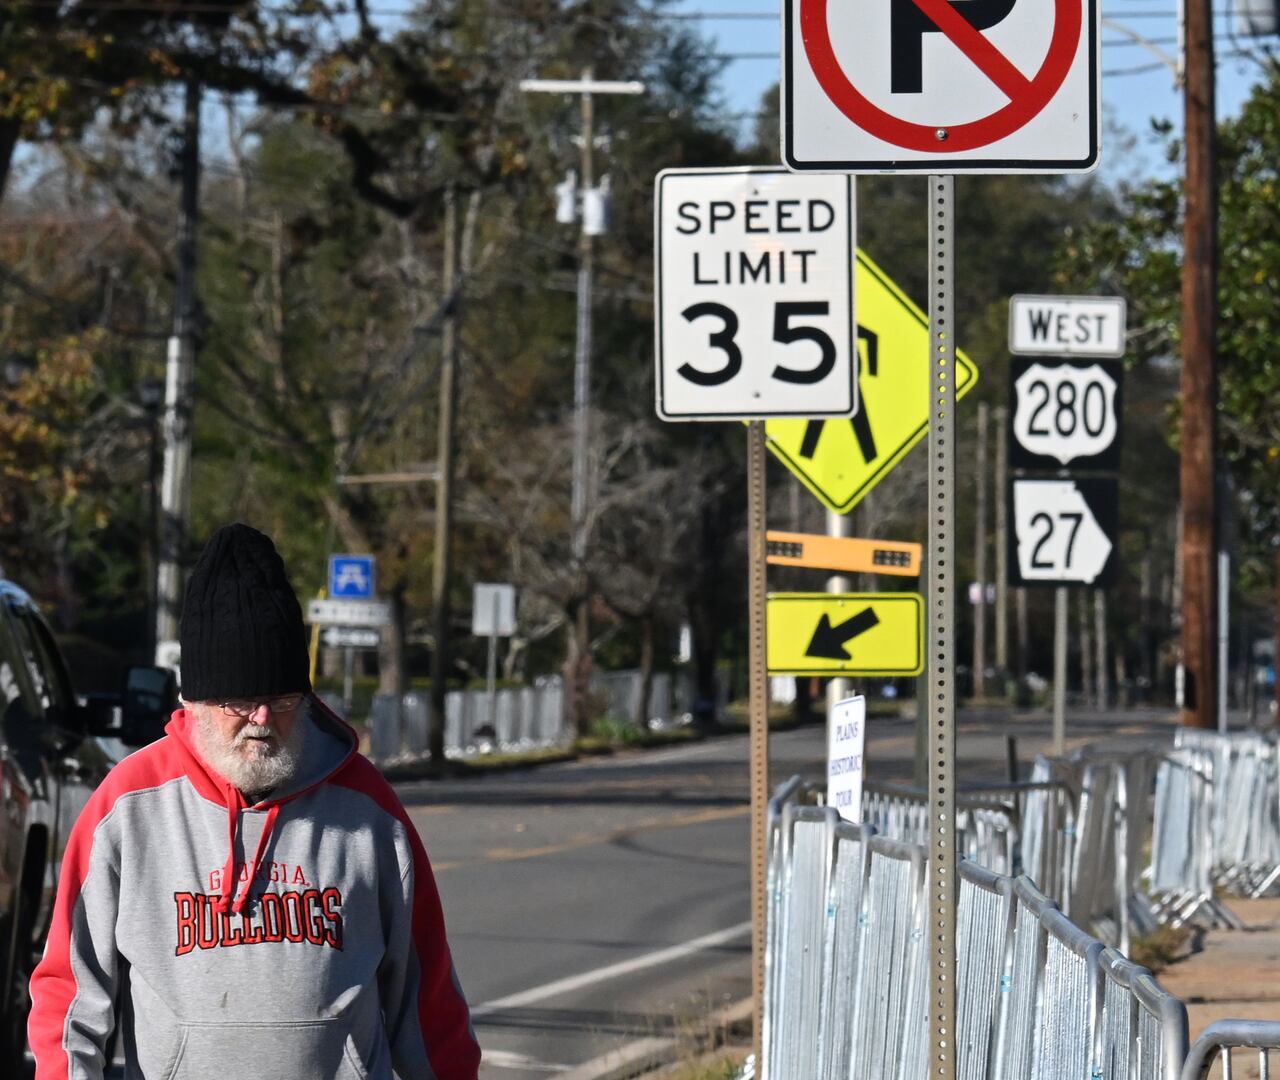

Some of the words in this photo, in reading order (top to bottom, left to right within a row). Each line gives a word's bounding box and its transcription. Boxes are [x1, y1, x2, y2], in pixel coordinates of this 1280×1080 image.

[676, 199, 835, 235] SPEED
[693, 250, 816, 285] LIMIT
[677, 301, 837, 387] 35
[1028, 309, 1107, 343] WEST
[1028, 381, 1106, 437] 280
[1030, 513, 1083, 569] 27
[836, 722, 859, 742] PLAINS
[174, 887, 344, 957] BULLDOGS
